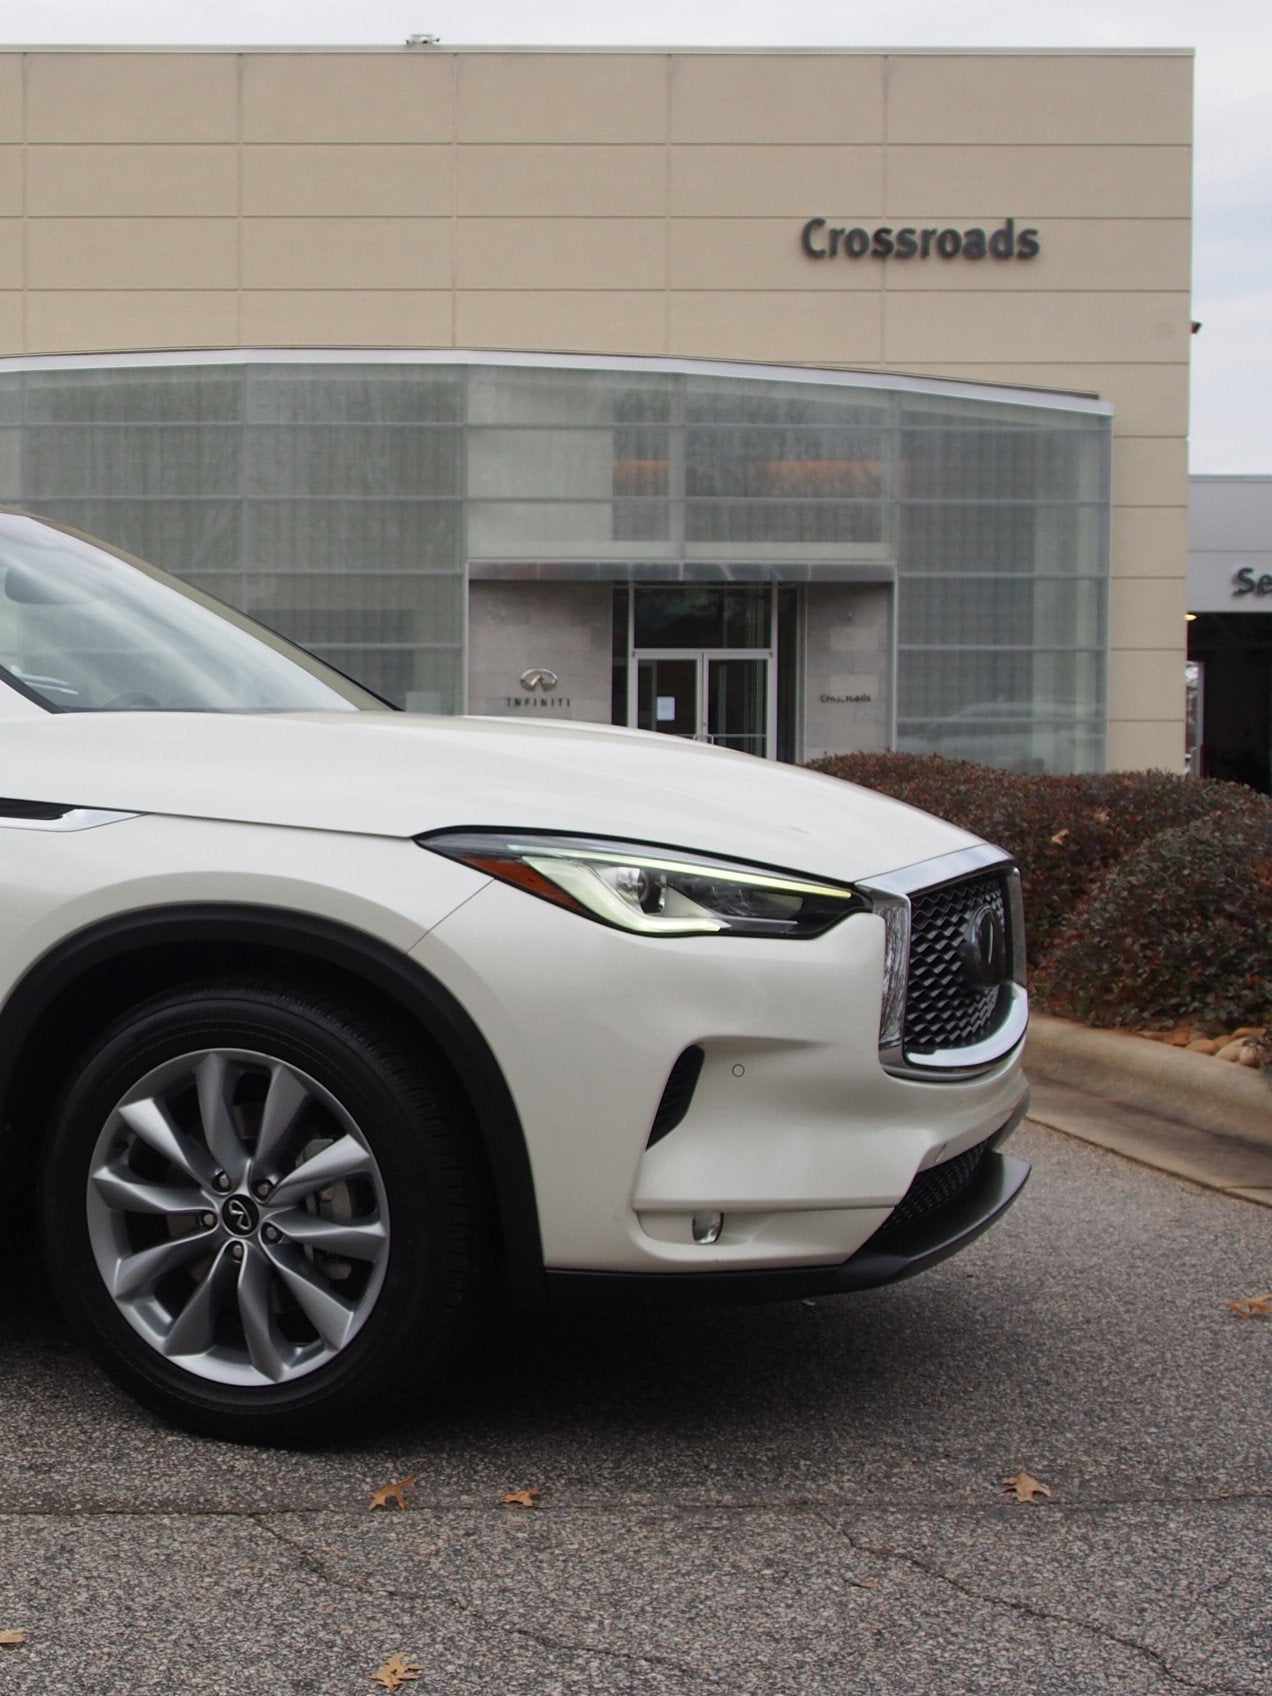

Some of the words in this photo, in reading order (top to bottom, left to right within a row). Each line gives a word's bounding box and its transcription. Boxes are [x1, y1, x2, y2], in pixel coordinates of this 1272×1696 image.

[801, 217, 1040, 260] Crossroads
[507, 698, 570, 707] INFINITI
[820, 694, 871, 703] Croroads
